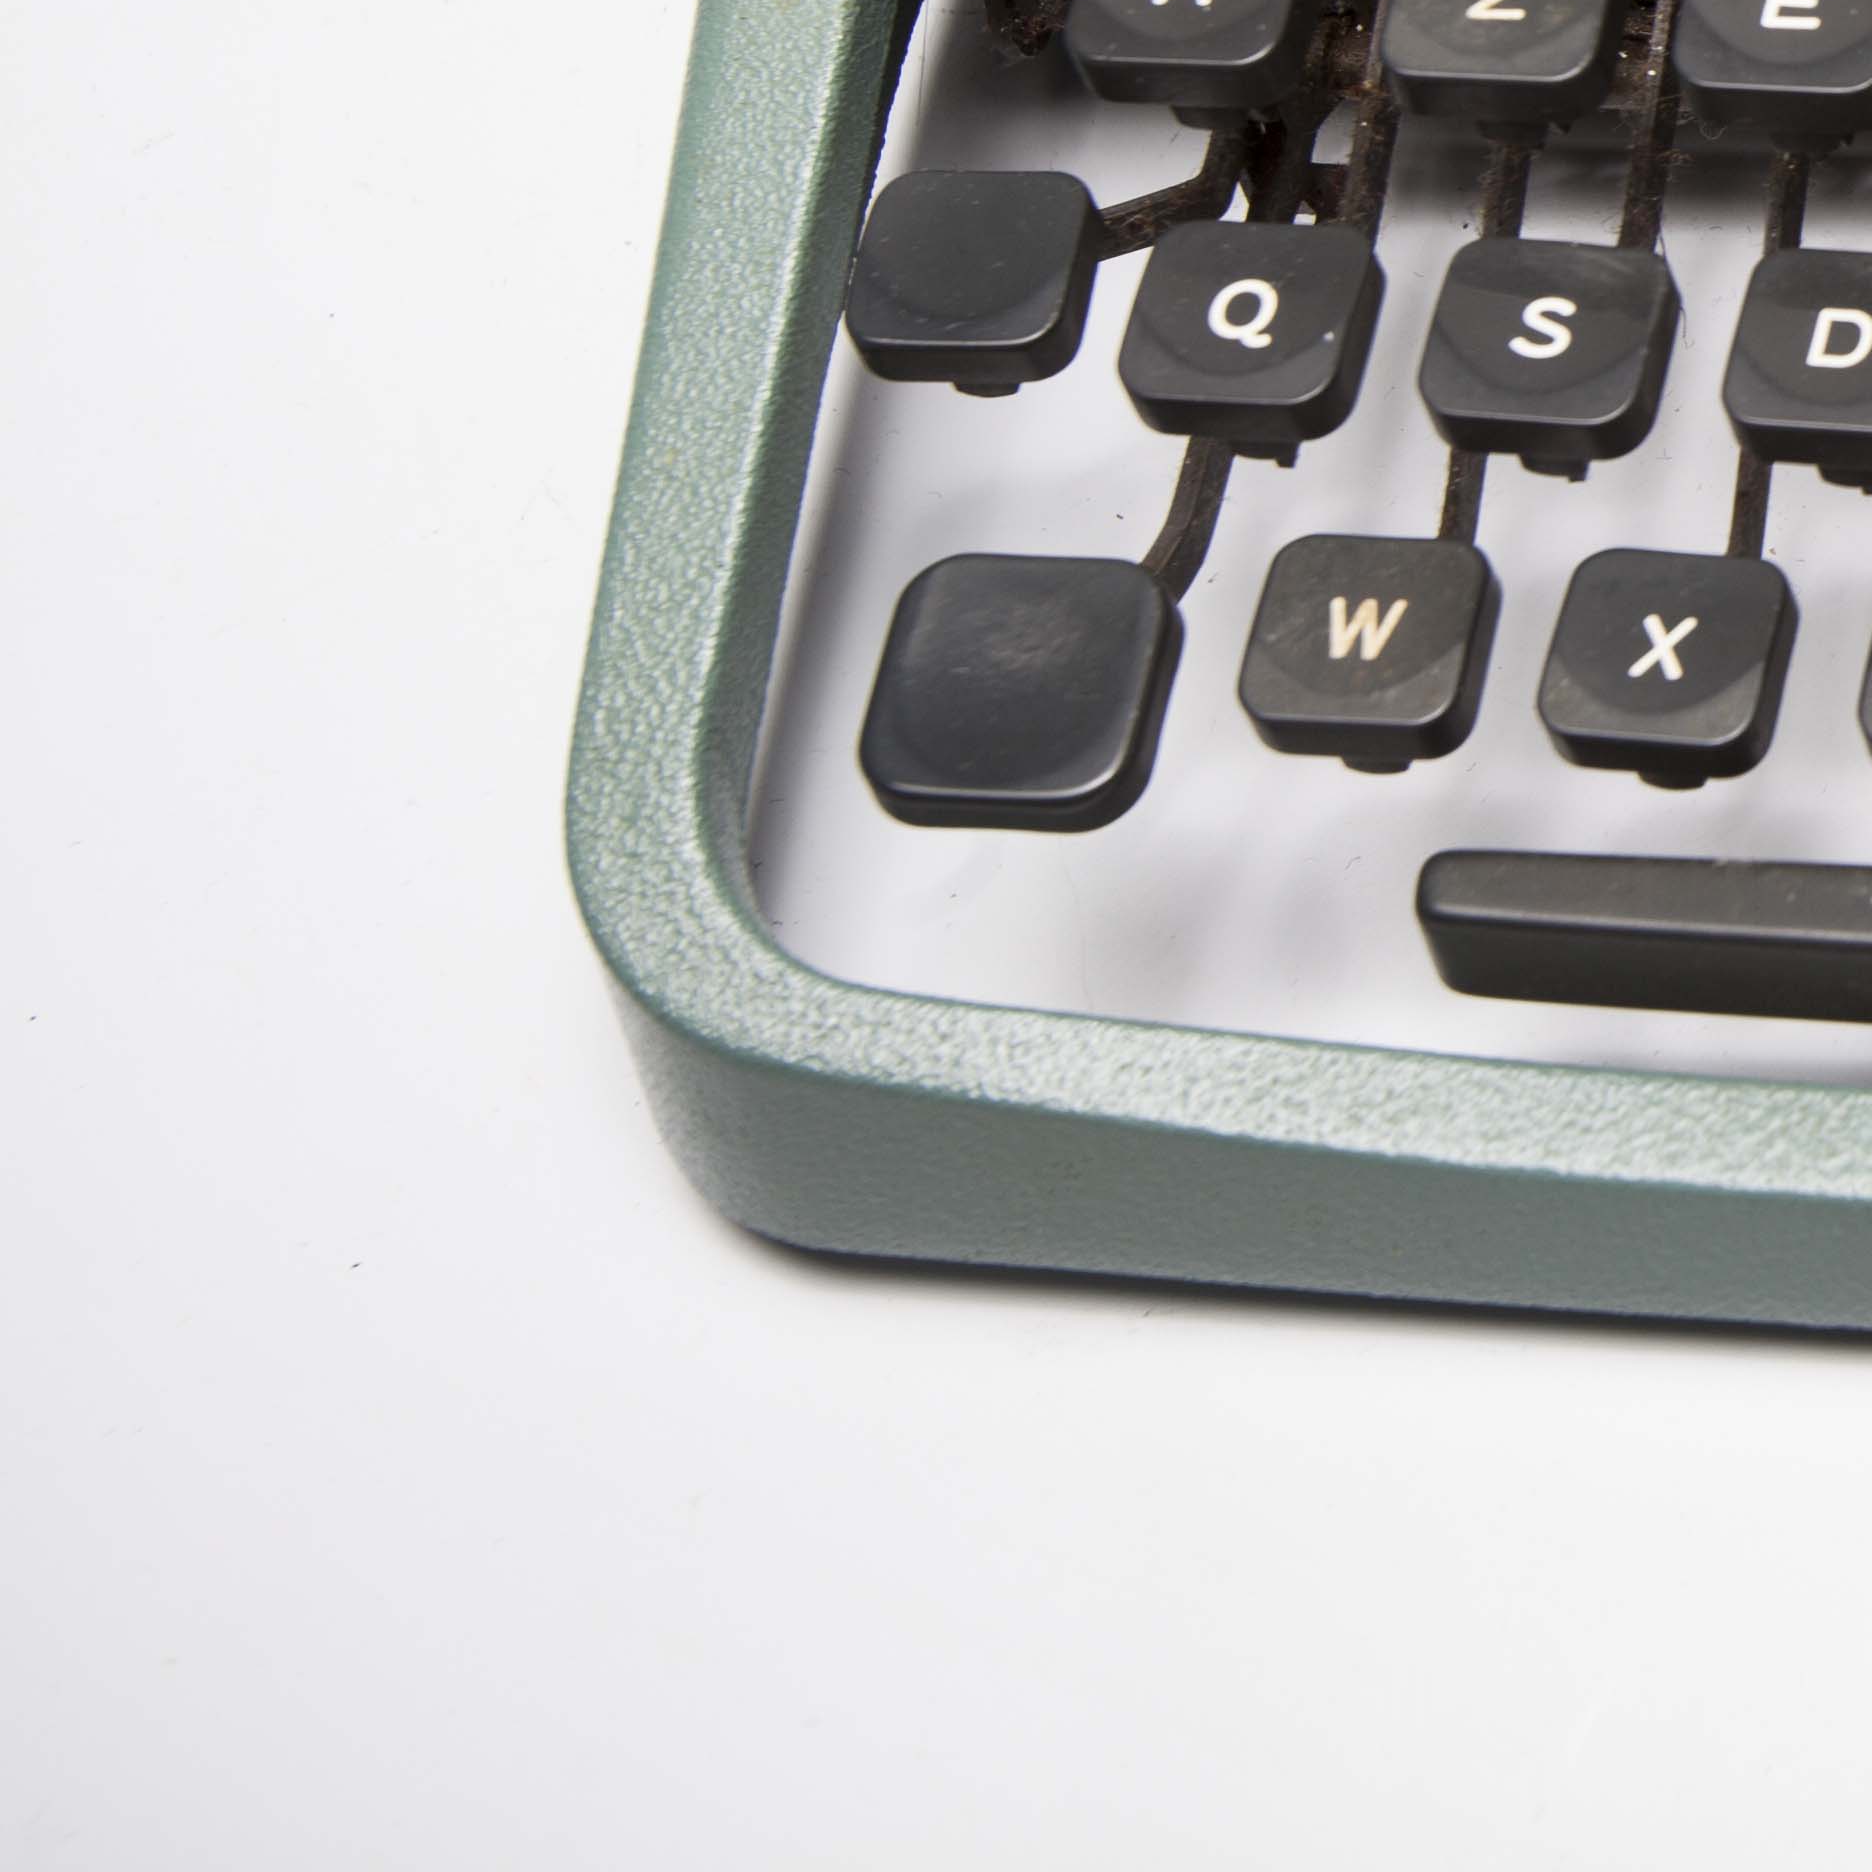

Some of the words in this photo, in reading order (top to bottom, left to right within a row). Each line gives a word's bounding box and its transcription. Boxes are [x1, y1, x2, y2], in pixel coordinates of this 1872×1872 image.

[1207, 278, 1279, 349] Q
[1508, 296, 1577, 359] S
[1329, 596, 1408, 661] W
[1628, 614, 1698, 681] X
